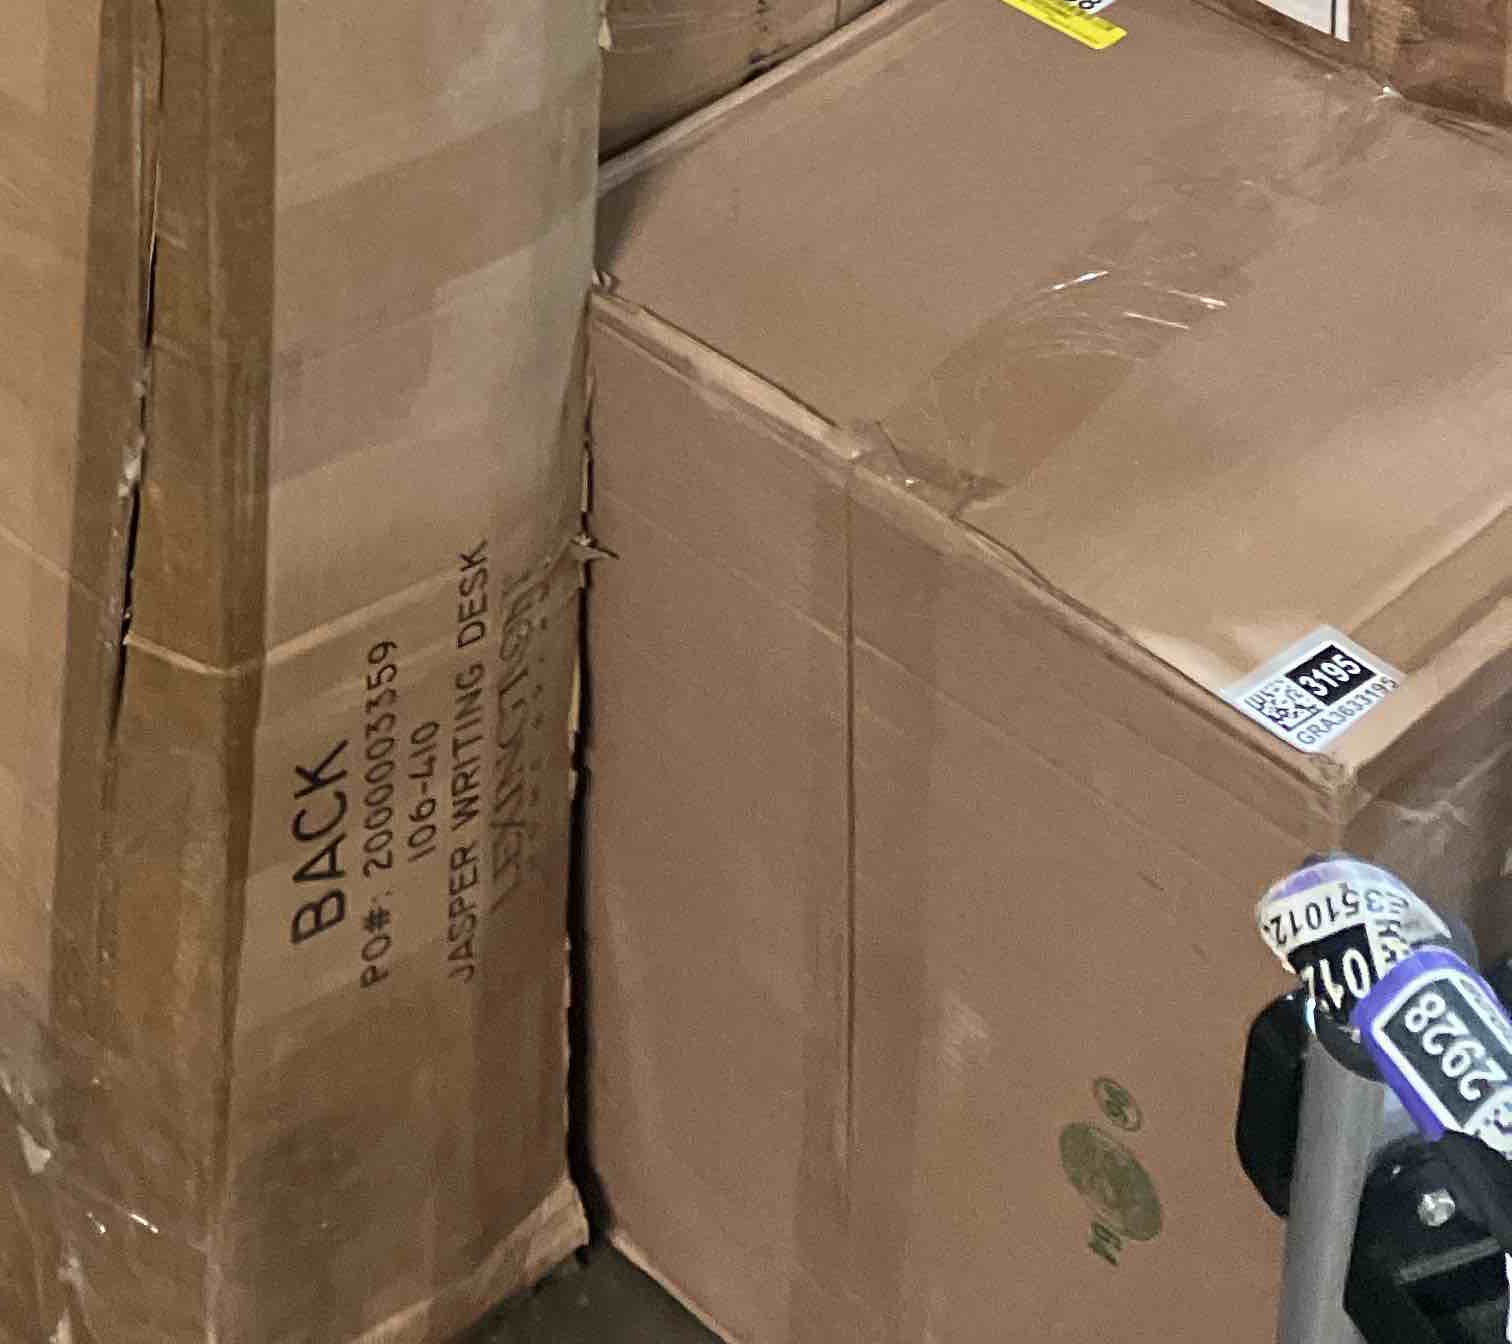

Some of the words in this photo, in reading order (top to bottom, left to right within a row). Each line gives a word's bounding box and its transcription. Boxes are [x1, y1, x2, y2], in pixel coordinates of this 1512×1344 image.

[457, 540, 490, 649] DESK
[1296, 678, 1400, 745] GRA3633195
[1298, 653, 1362, 697] 3195
[362, 640, 398, 878] 2000003359
[407, 721, 440, 864] 106-410
[452, 662, 484, 836] WRITING
[291, 739, 349, 945] BACK
[448, 838, 482, 986] JASPER
[1404, 992, 1509, 1102] 2928
